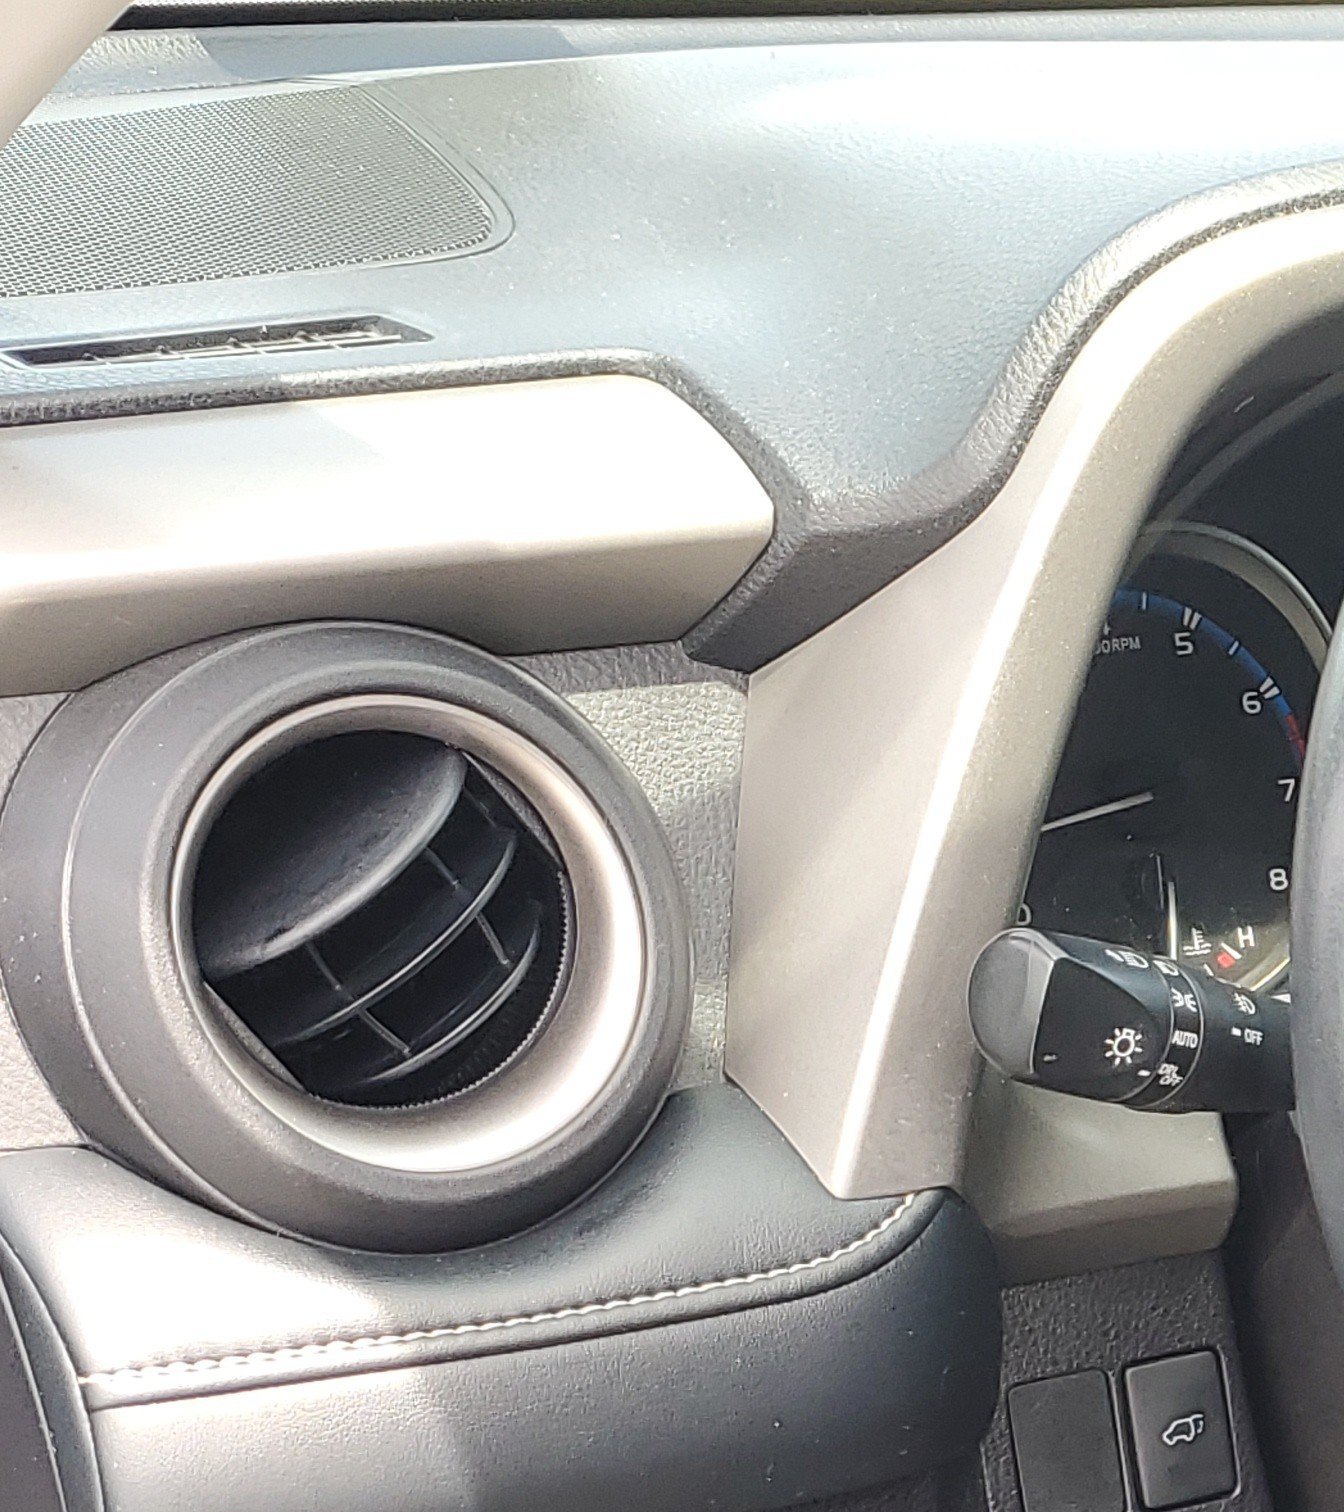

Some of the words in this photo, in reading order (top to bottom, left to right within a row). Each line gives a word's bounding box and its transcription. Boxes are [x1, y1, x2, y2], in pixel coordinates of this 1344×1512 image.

[1174, 631, 1194, 656] 5
[1241, 690, 1262, 715] 6
[1277, 778, 1297, 802] 7
[1269, 868, 1289, 891] 8
[1237, 925, 1256, 949] H
[1172, 1029, 1199, 1049] AUTO
[1244, 1027, 1264, 1046] OFF
